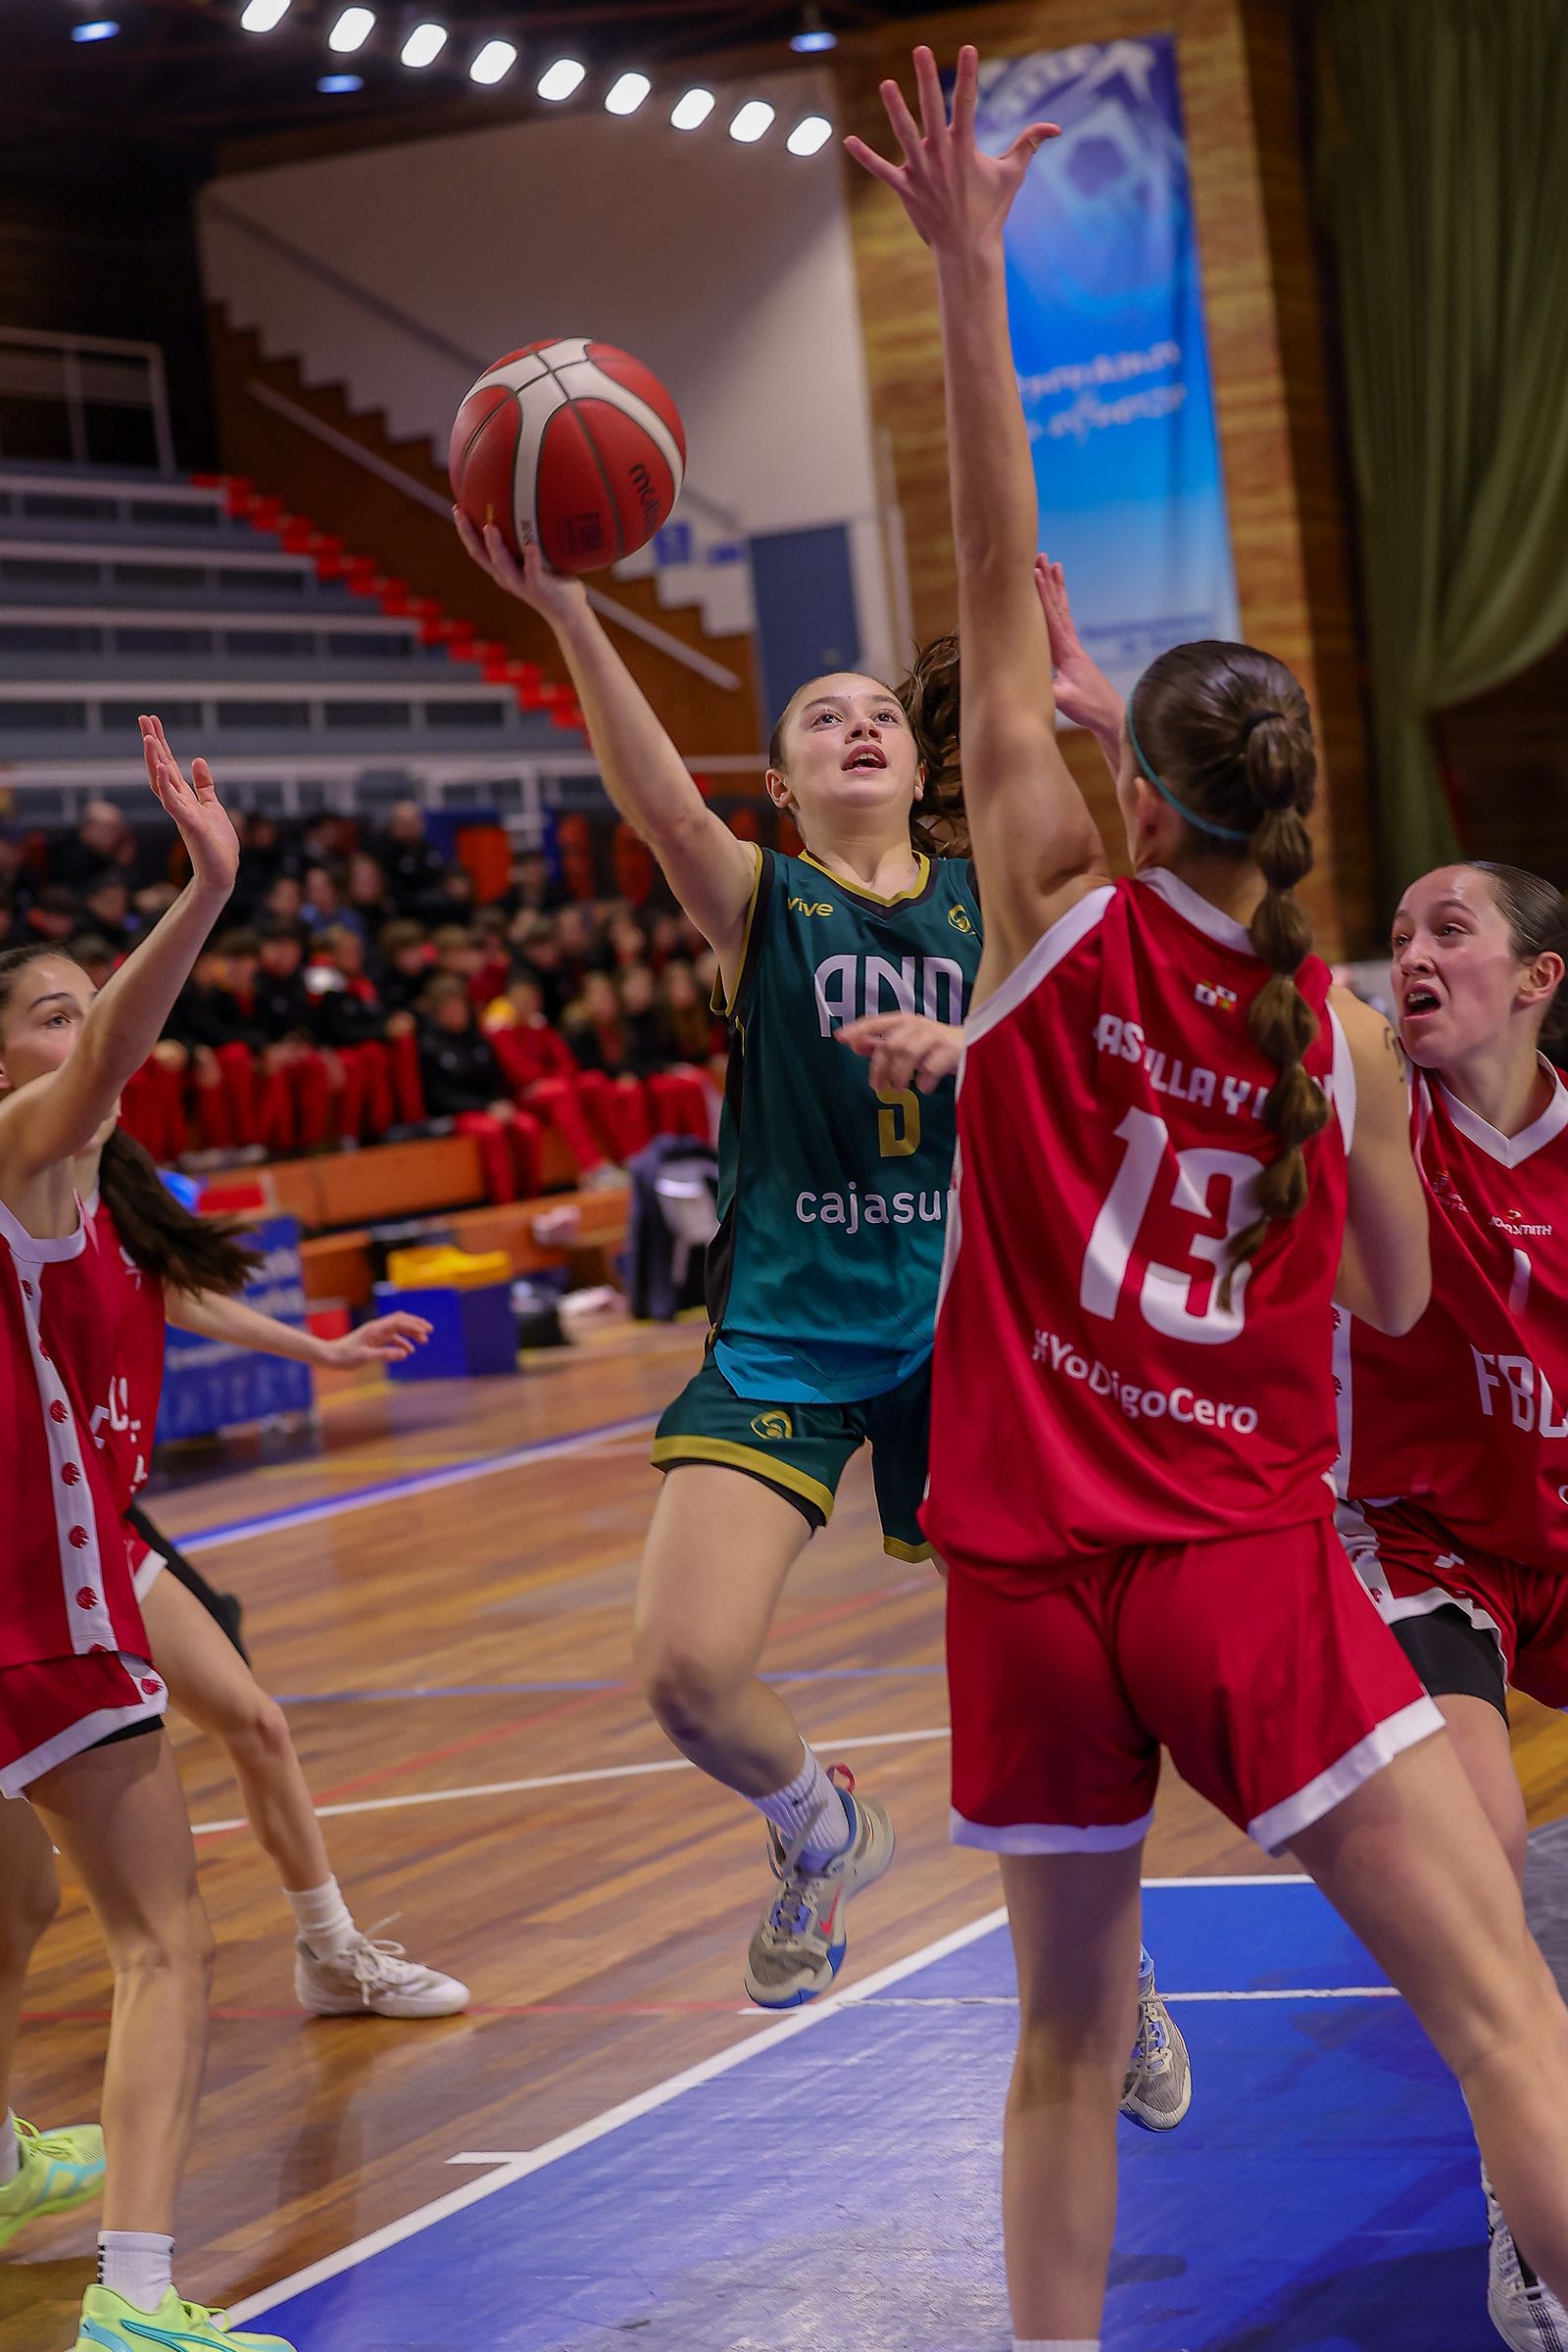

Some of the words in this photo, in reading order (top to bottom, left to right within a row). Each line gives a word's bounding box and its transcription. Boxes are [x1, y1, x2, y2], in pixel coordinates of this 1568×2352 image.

[787, 896, 834, 917] vive
[1221, 1075, 1252, 1115] Y
[1079, 1105, 1266, 1345] 13
[1031, 1328, 1258, 1435] #YoDigoCero
